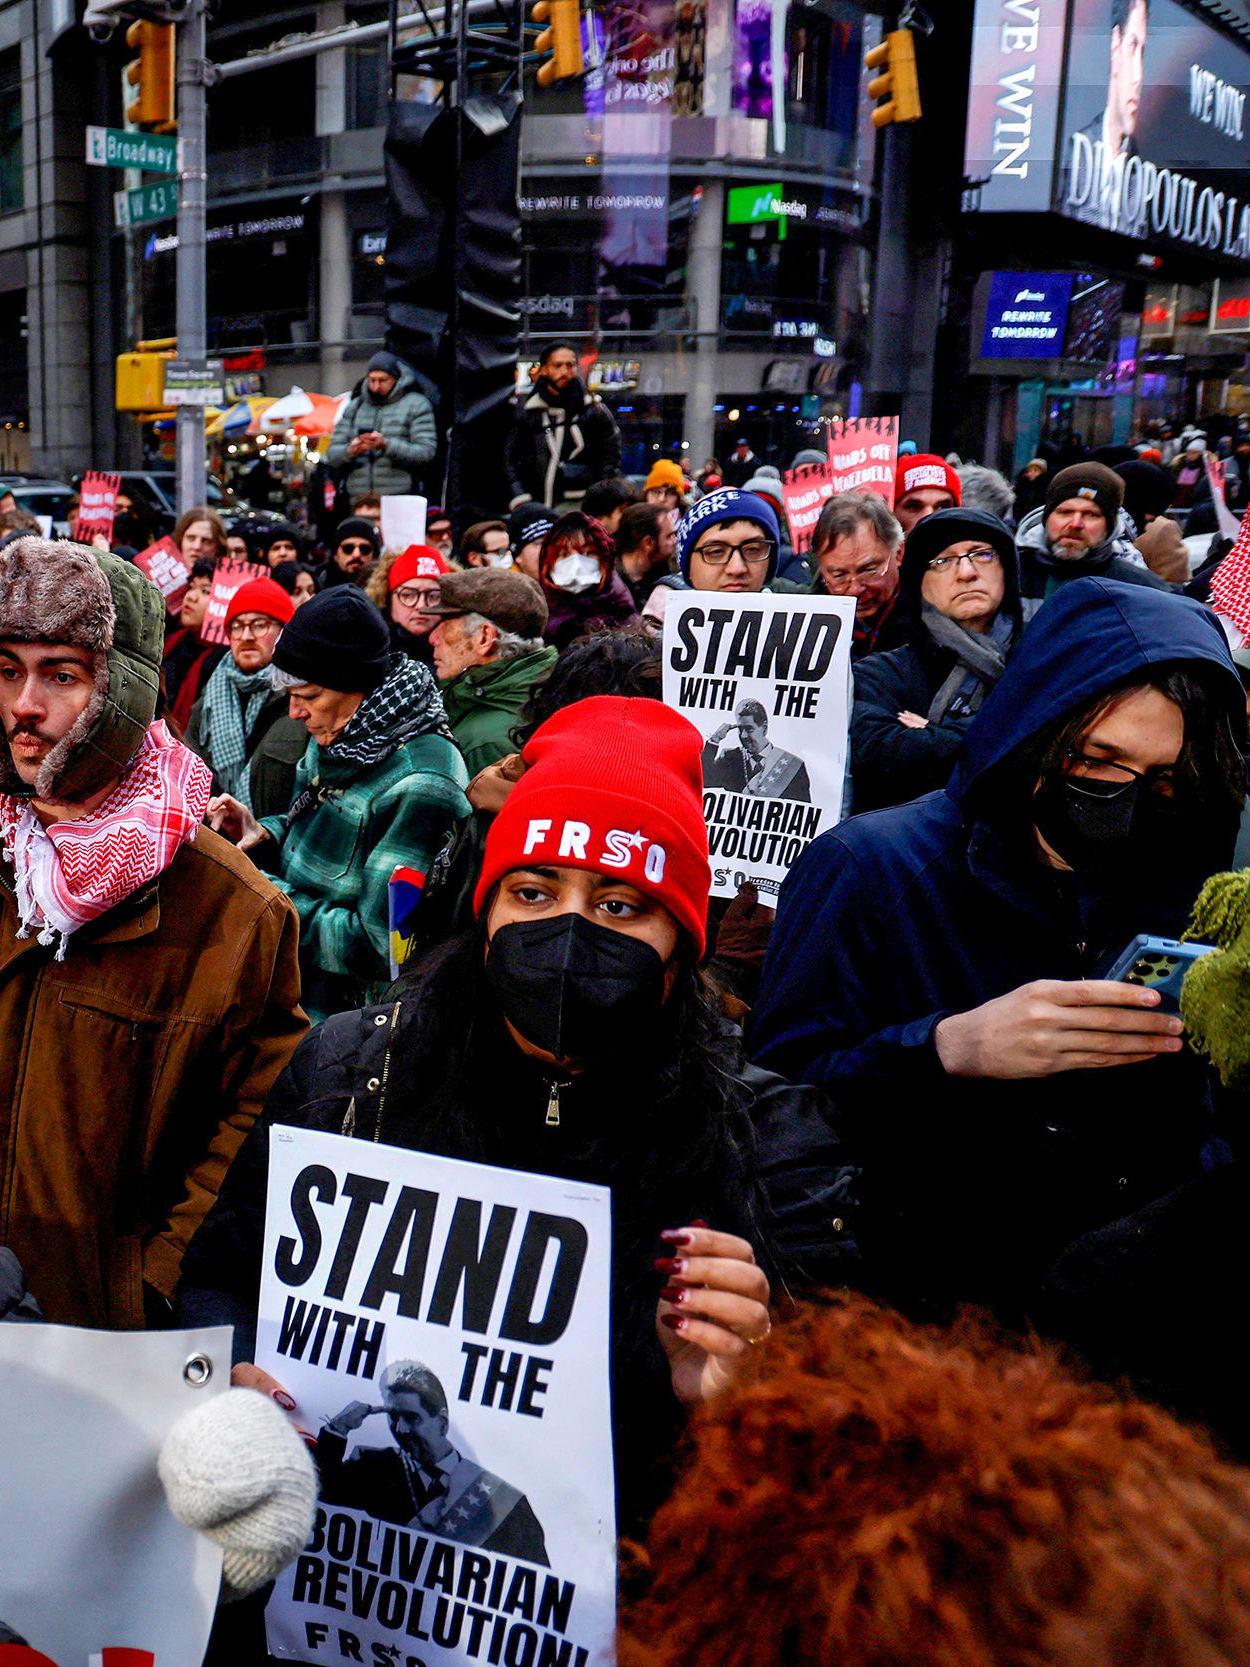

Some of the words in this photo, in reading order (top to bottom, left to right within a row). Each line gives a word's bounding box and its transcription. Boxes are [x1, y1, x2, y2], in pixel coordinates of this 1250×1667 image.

[1190, 63, 1215, 124] WE
[990, 64, 1036, 180] WIN
[107, 134, 174, 171] Broadway
[130, 190, 144, 219] W
[150, 186, 167, 215] 43
[238, 214, 305, 237] TOMORROW
[991, 326, 1059, 339] TOMORROW
[869, 443, 892, 461] OFF
[688, 491, 741, 518] LAKE
[670, 607, 842, 682] STAND
[679, 676, 738, 711] WITH
[773, 684, 821, 719] THE
[703, 792, 823, 840] OLIVARIAN
[523, 819, 667, 884] FRSO
[706, 825, 811, 869] VOLUTIO
[274, 1164, 589, 1346] STAND
[276, 1295, 387, 1381] WITH
[457, 1341, 554, 1419] THE
[303, 1507, 576, 1635] BOLIVARIAN
[292, 1555, 591, 1667] REVOLUTION!
